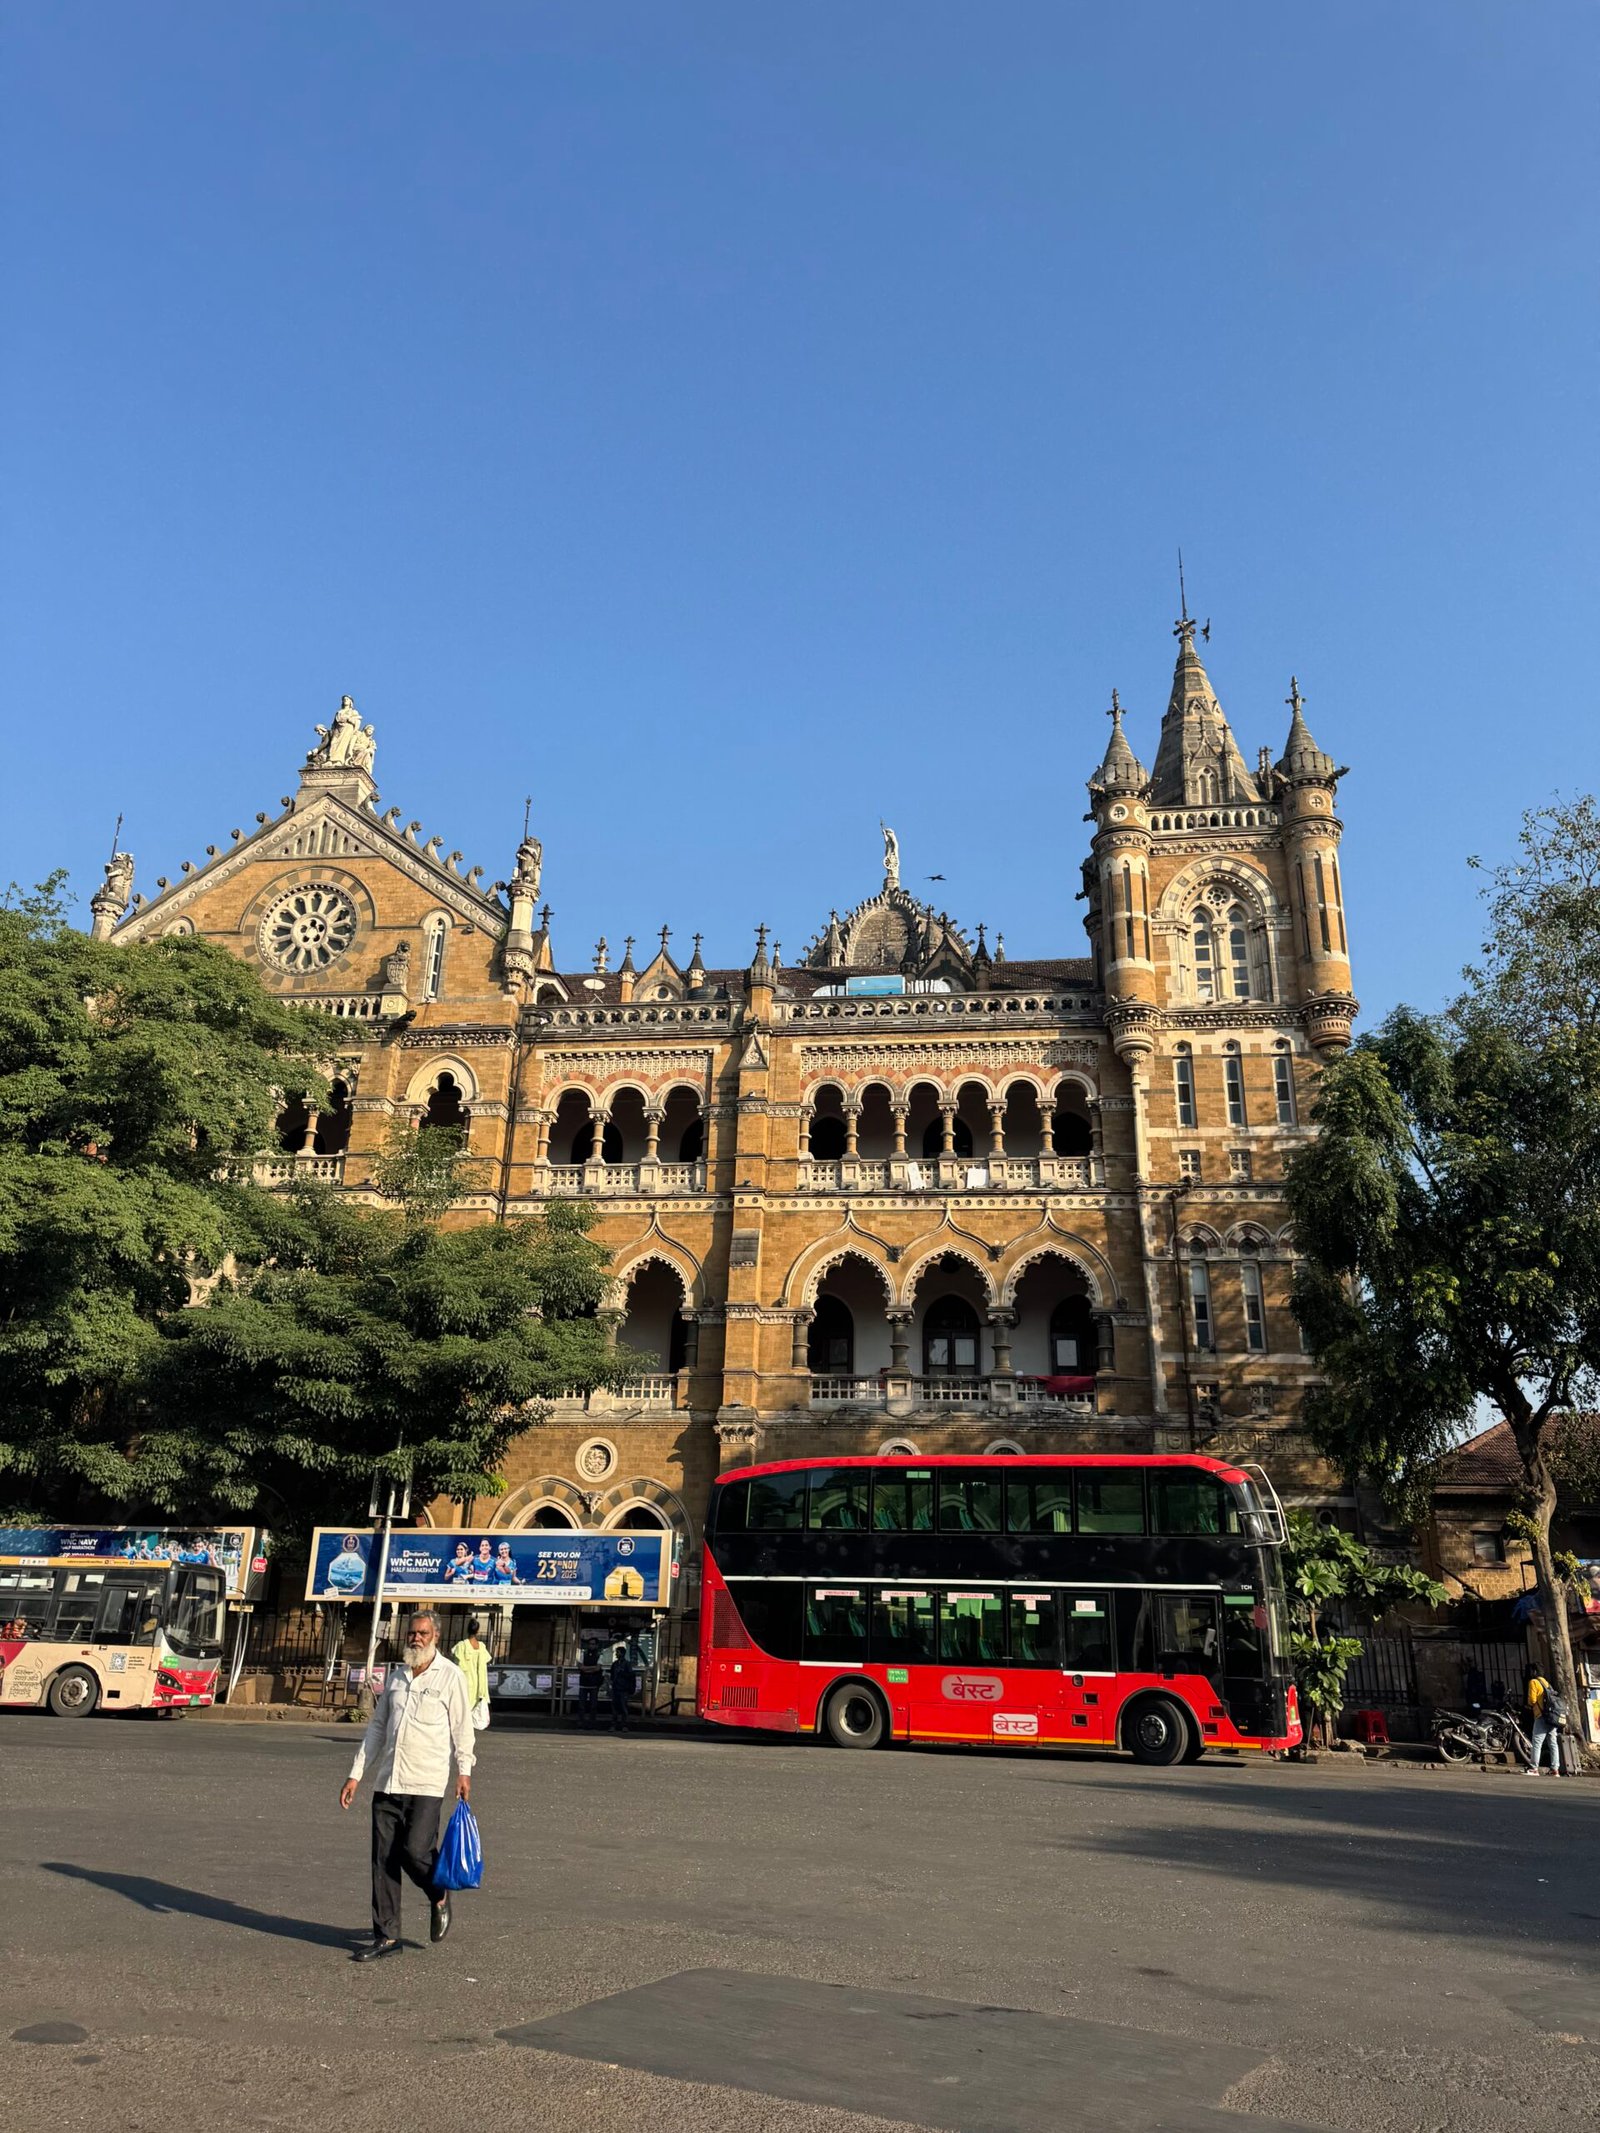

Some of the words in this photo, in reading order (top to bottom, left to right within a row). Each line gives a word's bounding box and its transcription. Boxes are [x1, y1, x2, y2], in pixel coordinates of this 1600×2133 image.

[553, 1551, 569, 1559] YOU
[569, 1551, 581, 1559] ON
[390, 1558, 414, 1567] WNC
[414, 1558, 442, 1567] NAVY
[537, 1559, 558, 1579] 23
[561, 1560, 578, 1570] NOV
[561, 1570, 577, 1579] 2025
[951, 1675, 996, 1699] बेस्ट
[994, 1714, 1037, 1733] बेस्ट
